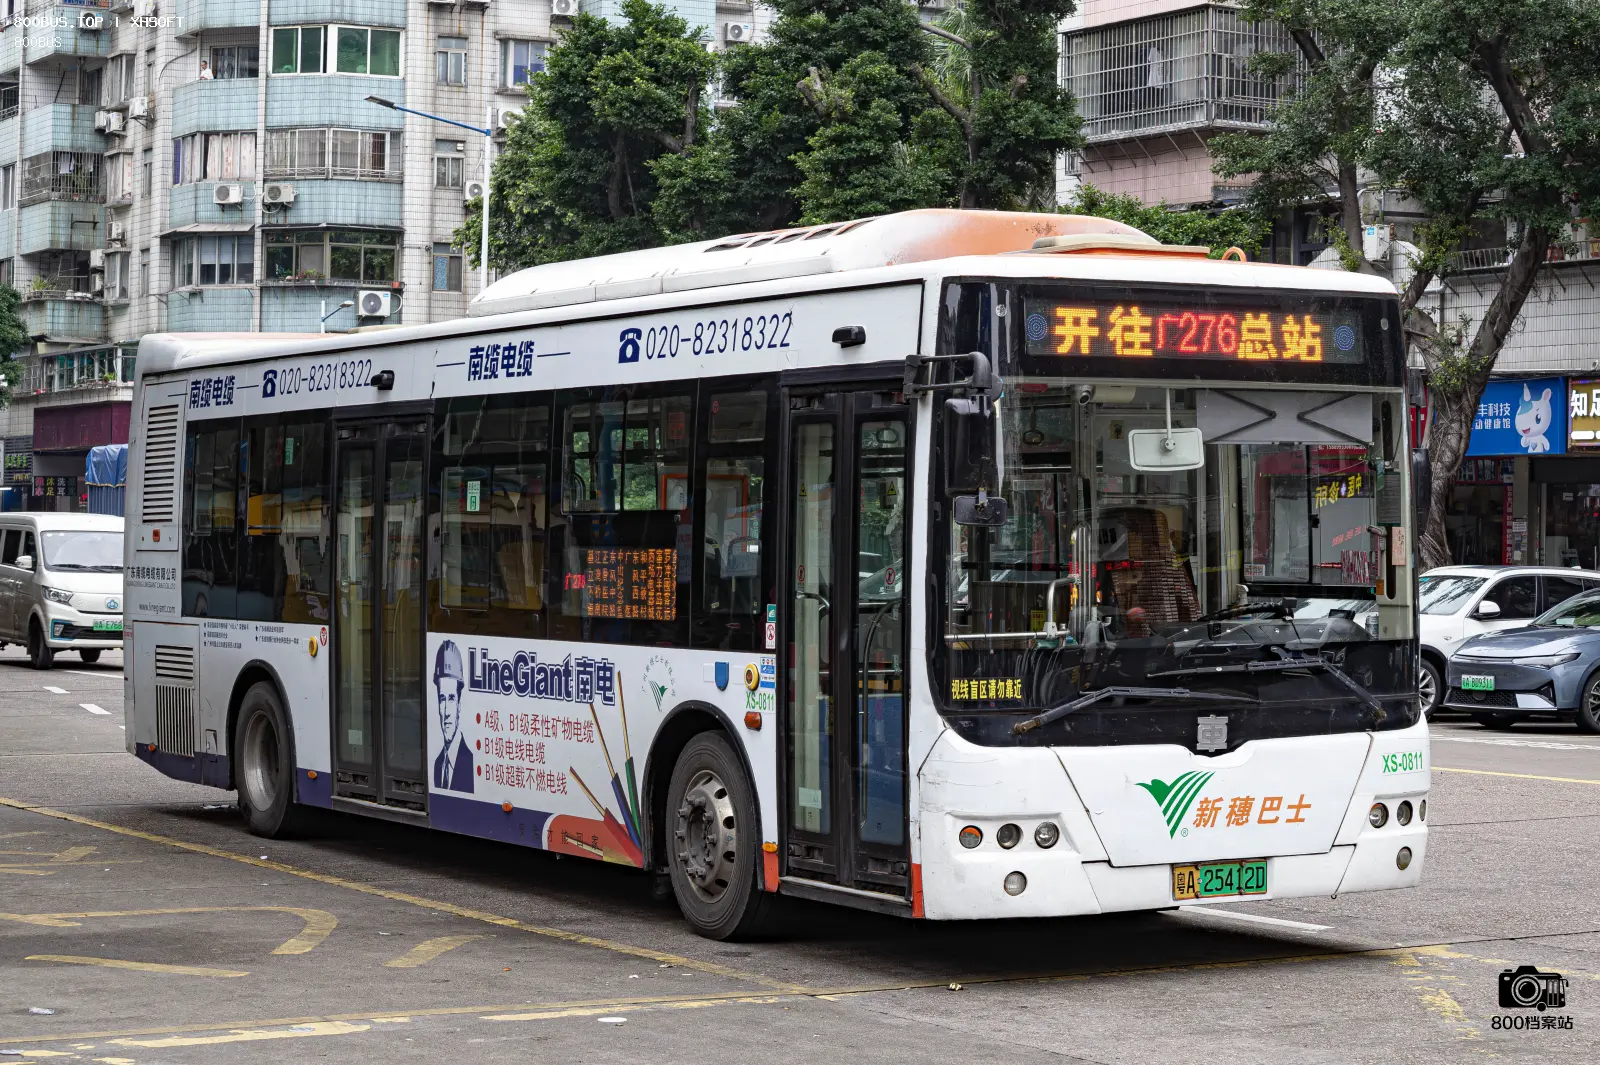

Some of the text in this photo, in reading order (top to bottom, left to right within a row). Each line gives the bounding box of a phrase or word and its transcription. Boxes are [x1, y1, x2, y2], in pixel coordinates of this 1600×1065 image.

[645, 313, 792, 360] 020-82318322
[279, 358, 372, 396] 020-82318322
[467, 340, 536, 382] 南缆电缆
[188, 375, 236, 410] 南缆电缆
[1470, 418, 1511, 431] 动健康馆
[468, 647, 616, 707] LineGiant 南电
[951, 678, 1022, 700] 视线盲区请勿靠近
[745, 691, 775, 711] XS-0811
[484, 738, 546, 765] B1级电线电缆
[1382, 751, 1424, 773] XS-0811
[485, 764, 568, 796] B1级超载不燃电线
[1193, 794, 1312, 828] 新穗巴士
